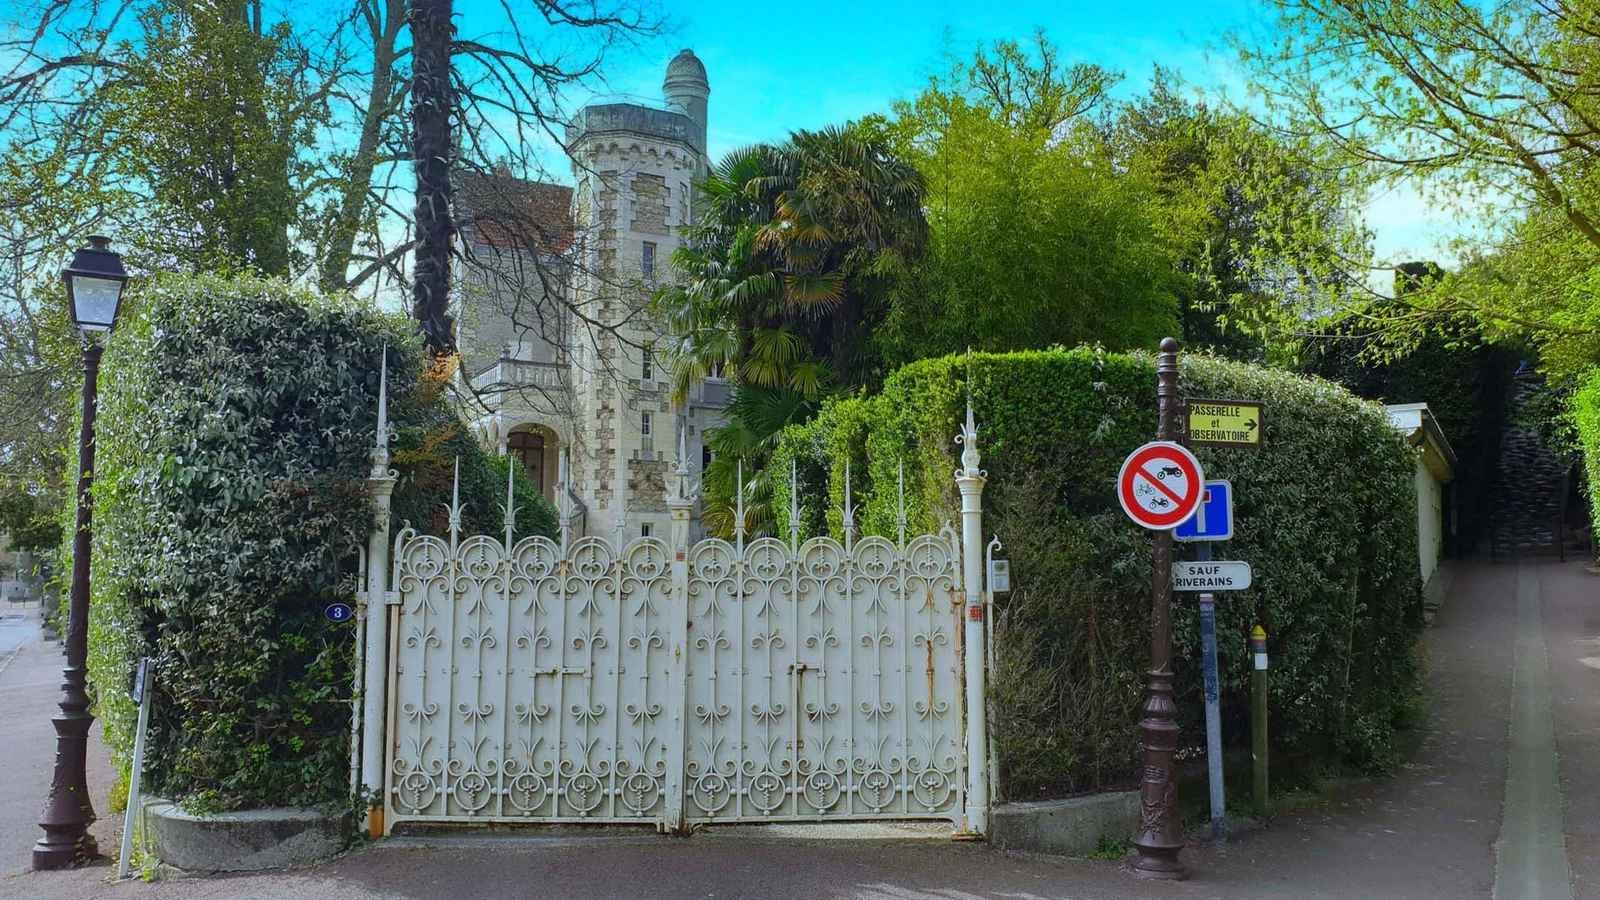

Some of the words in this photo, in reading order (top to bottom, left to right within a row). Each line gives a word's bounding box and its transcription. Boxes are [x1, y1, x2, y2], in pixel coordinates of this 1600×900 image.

[1190, 405, 1240, 417] PASSERELLE
[1211, 418, 1220, 428] et
[1190, 430, 1250, 441] OBSERVATOIRE
[1189, 566, 1220, 575] SAUF
[1175, 577, 1233, 587] RIVERAINS
[334, 607, 342, 618] 3
